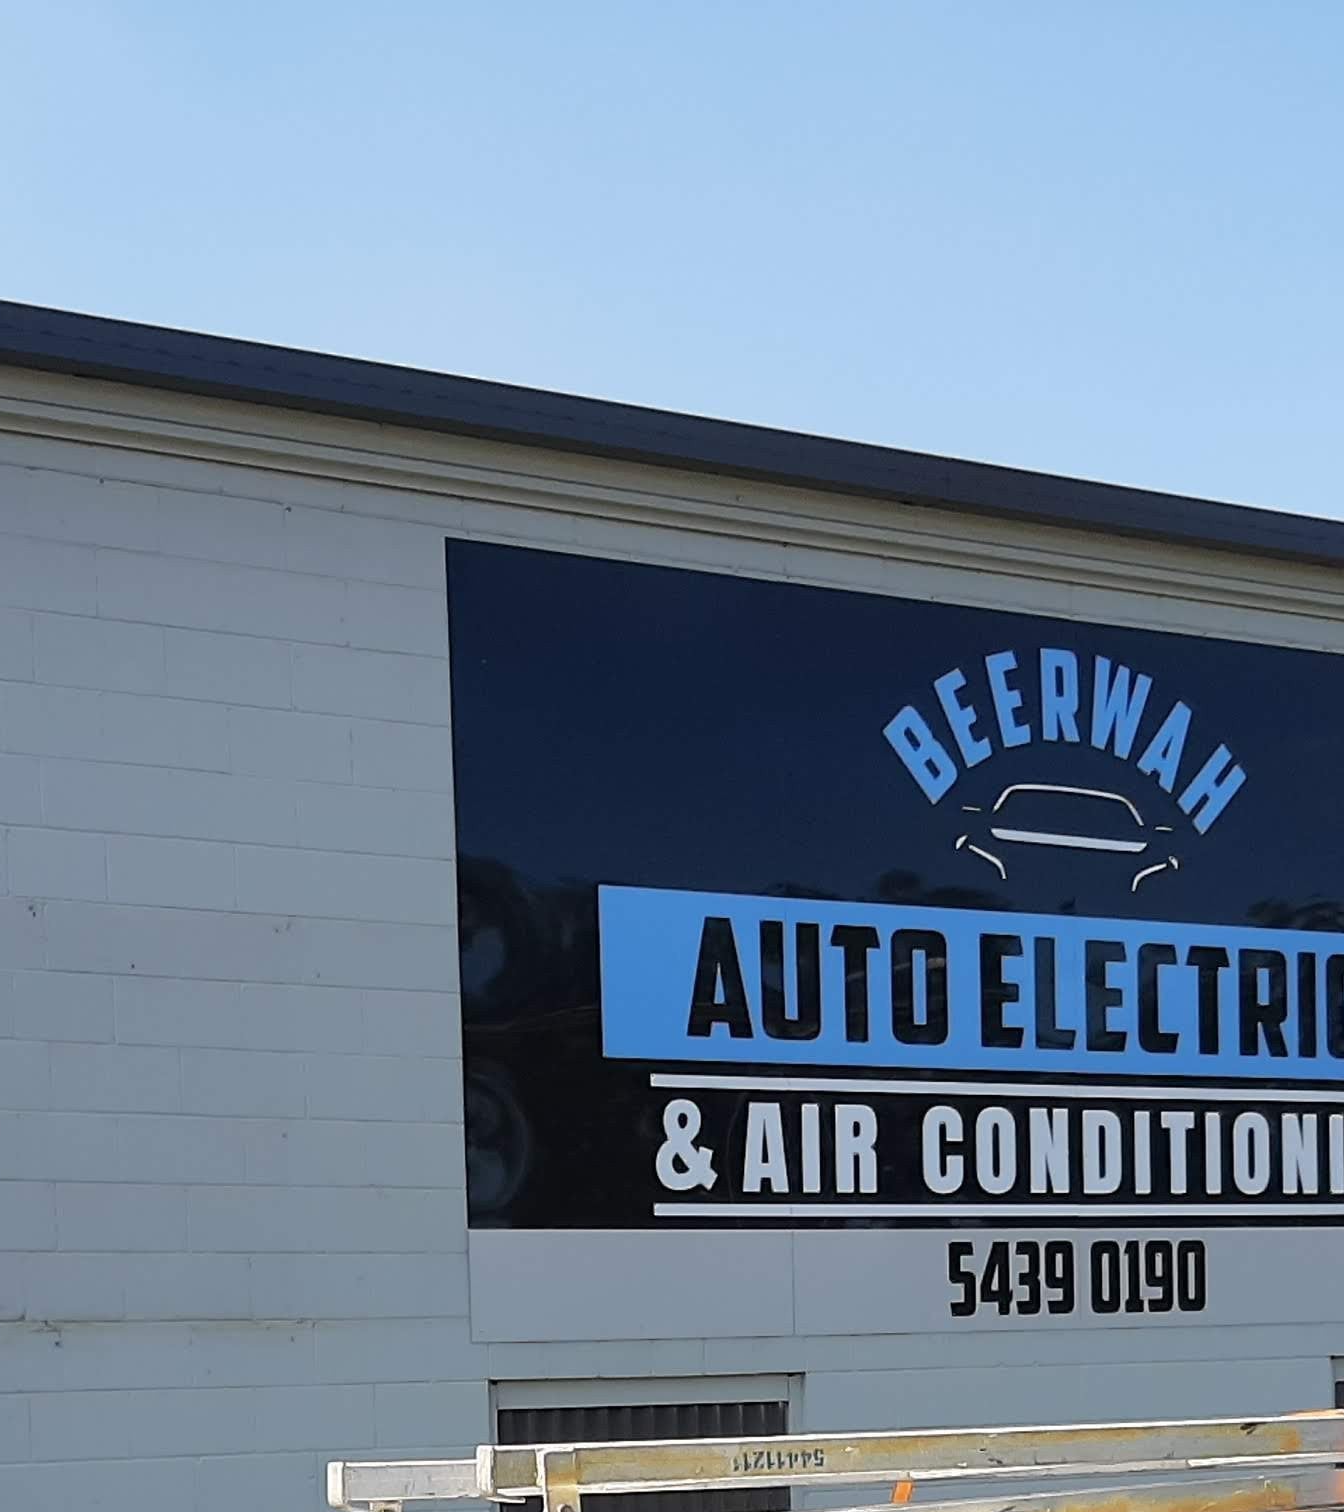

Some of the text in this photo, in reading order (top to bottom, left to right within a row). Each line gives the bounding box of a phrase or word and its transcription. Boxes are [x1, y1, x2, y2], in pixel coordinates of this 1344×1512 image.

[882, 647, 1246, 835] BEERWAH
[686, 916, 950, 1045] AUTO
[654, 1099, 717, 1194] &
[742, 1101, 878, 1195] AIR
[948, 1239, 1208, 1317] 5439 0190
